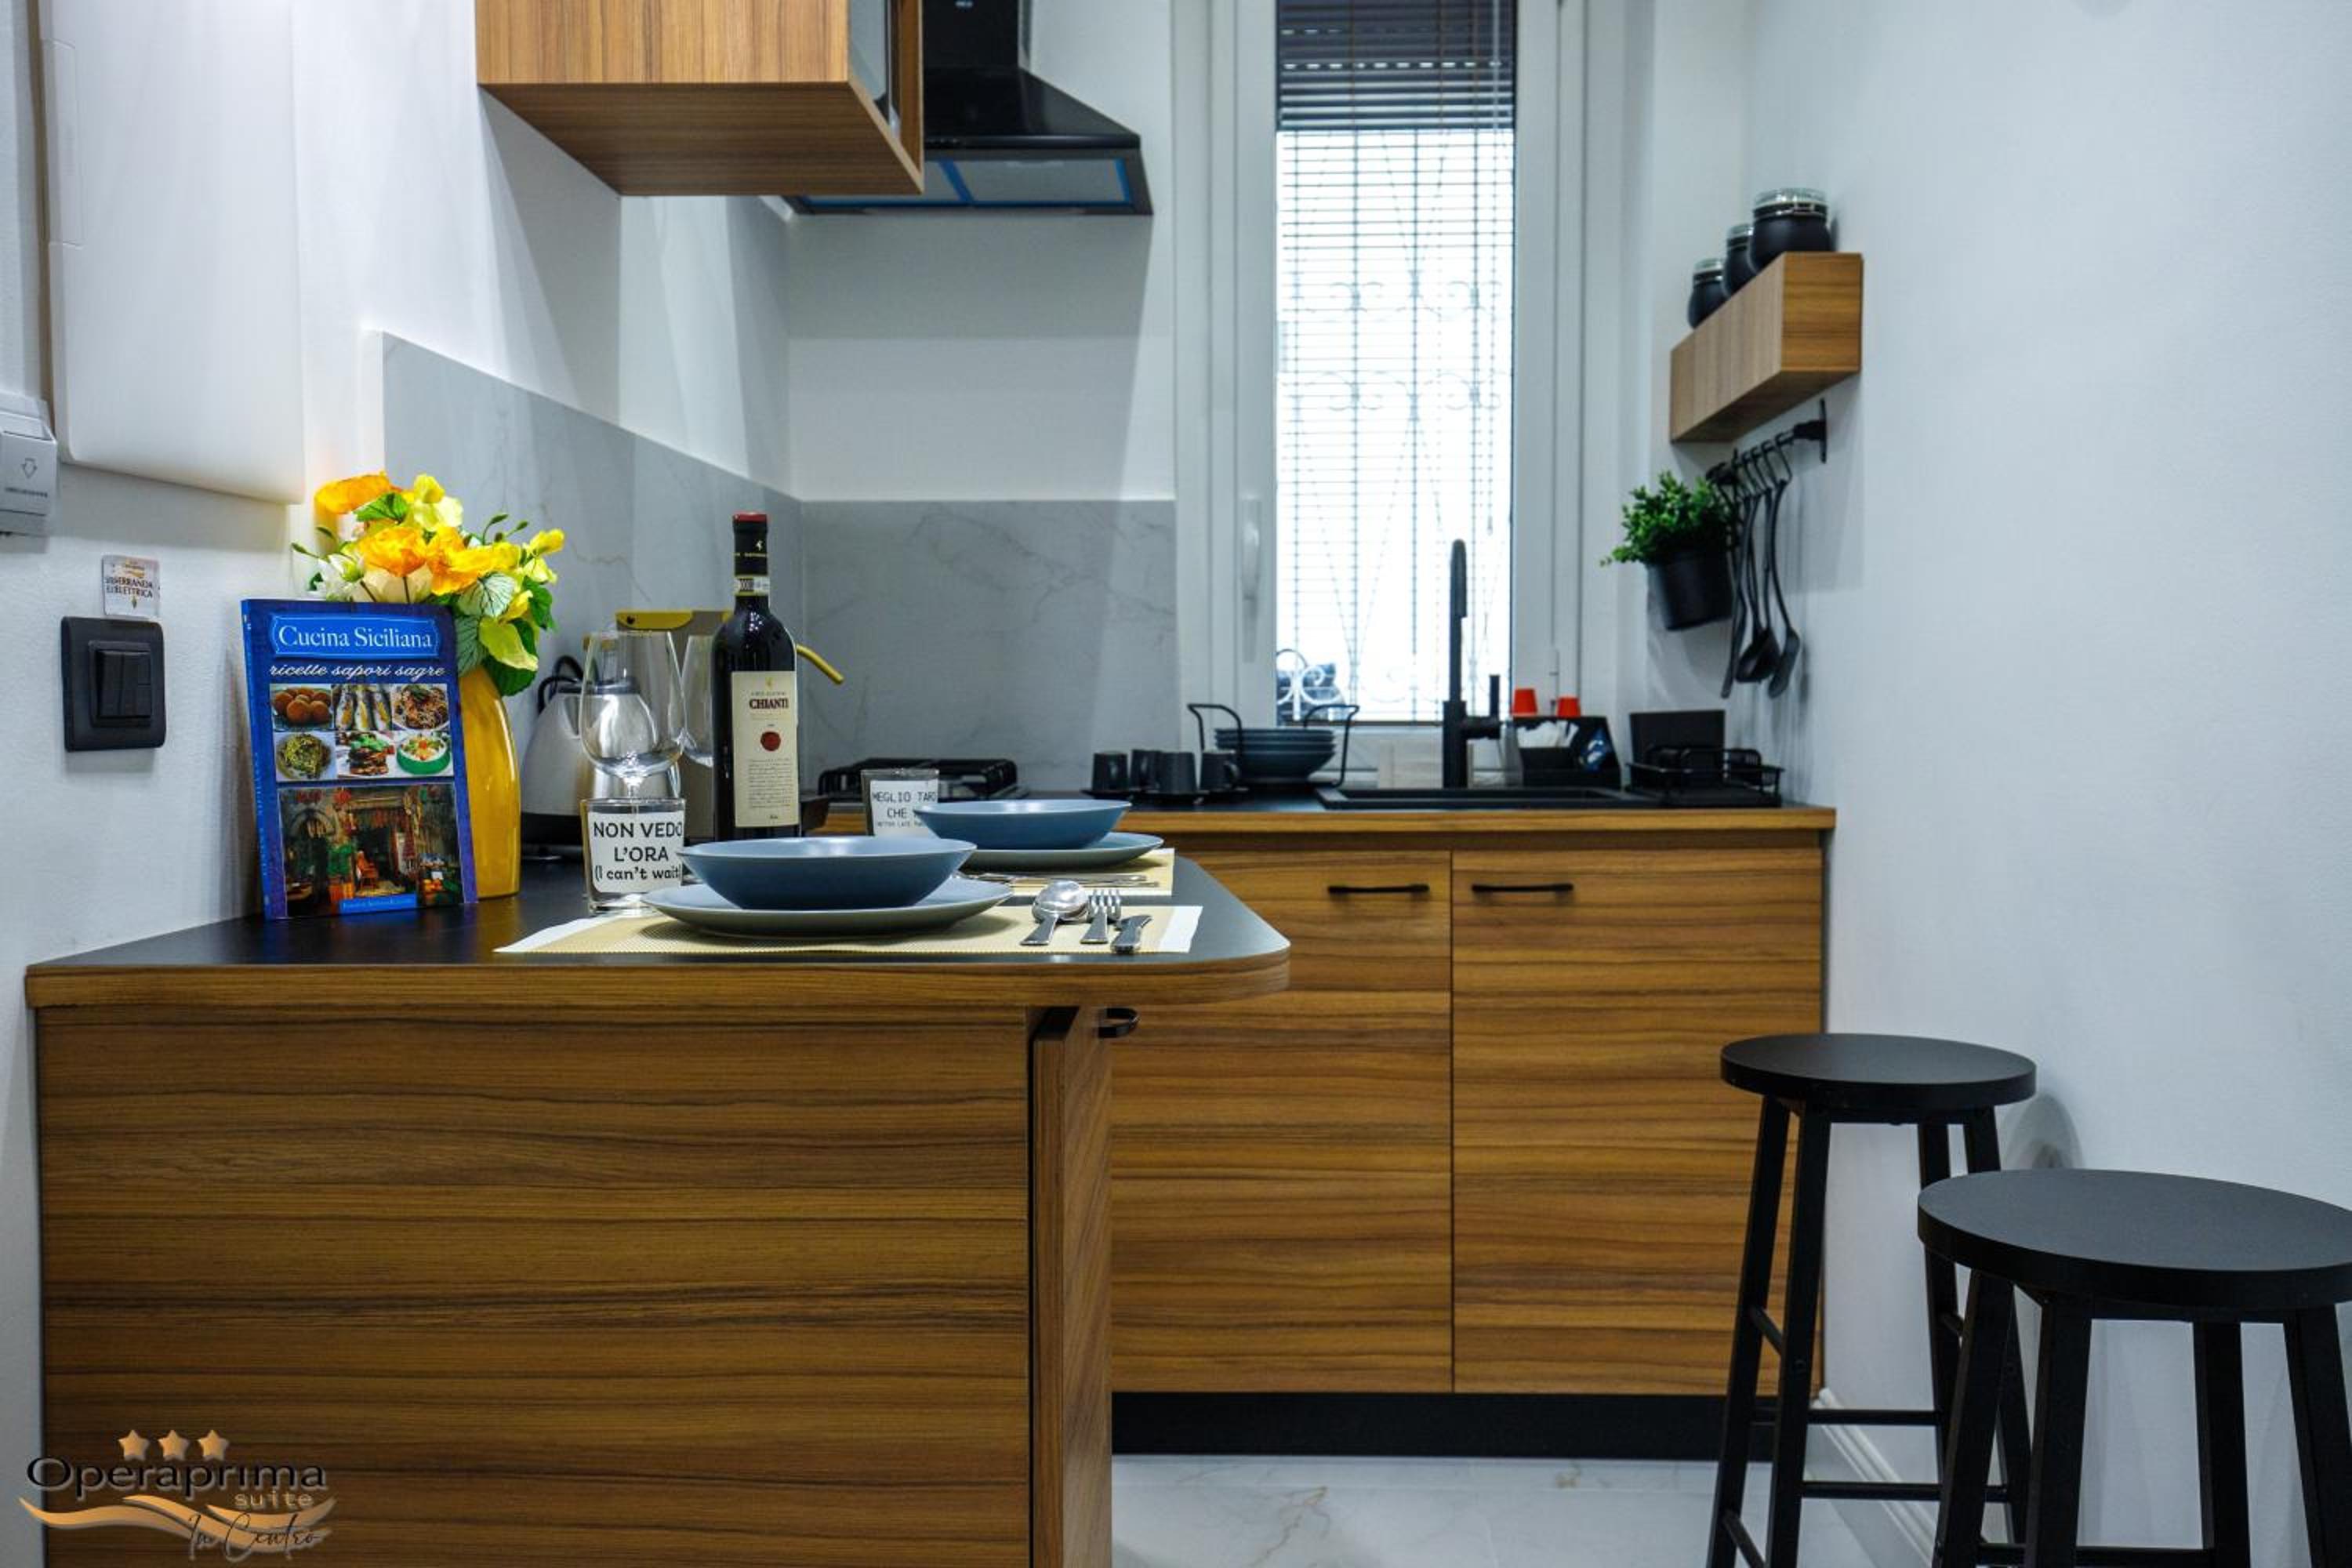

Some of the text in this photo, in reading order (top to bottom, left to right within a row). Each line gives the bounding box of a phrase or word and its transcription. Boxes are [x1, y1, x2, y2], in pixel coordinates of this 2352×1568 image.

[278, 625, 432, 648] Cucina Siciliana
[270, 665, 445, 681] ricette sapori sagre
[749, 697, 789, 710] CHIANTI
[887, 808, 907, 819] CHE
[593, 822, 634, 838] NON
[614, 846, 670, 862] L'ORA
[606, 866, 648, 880] can't
